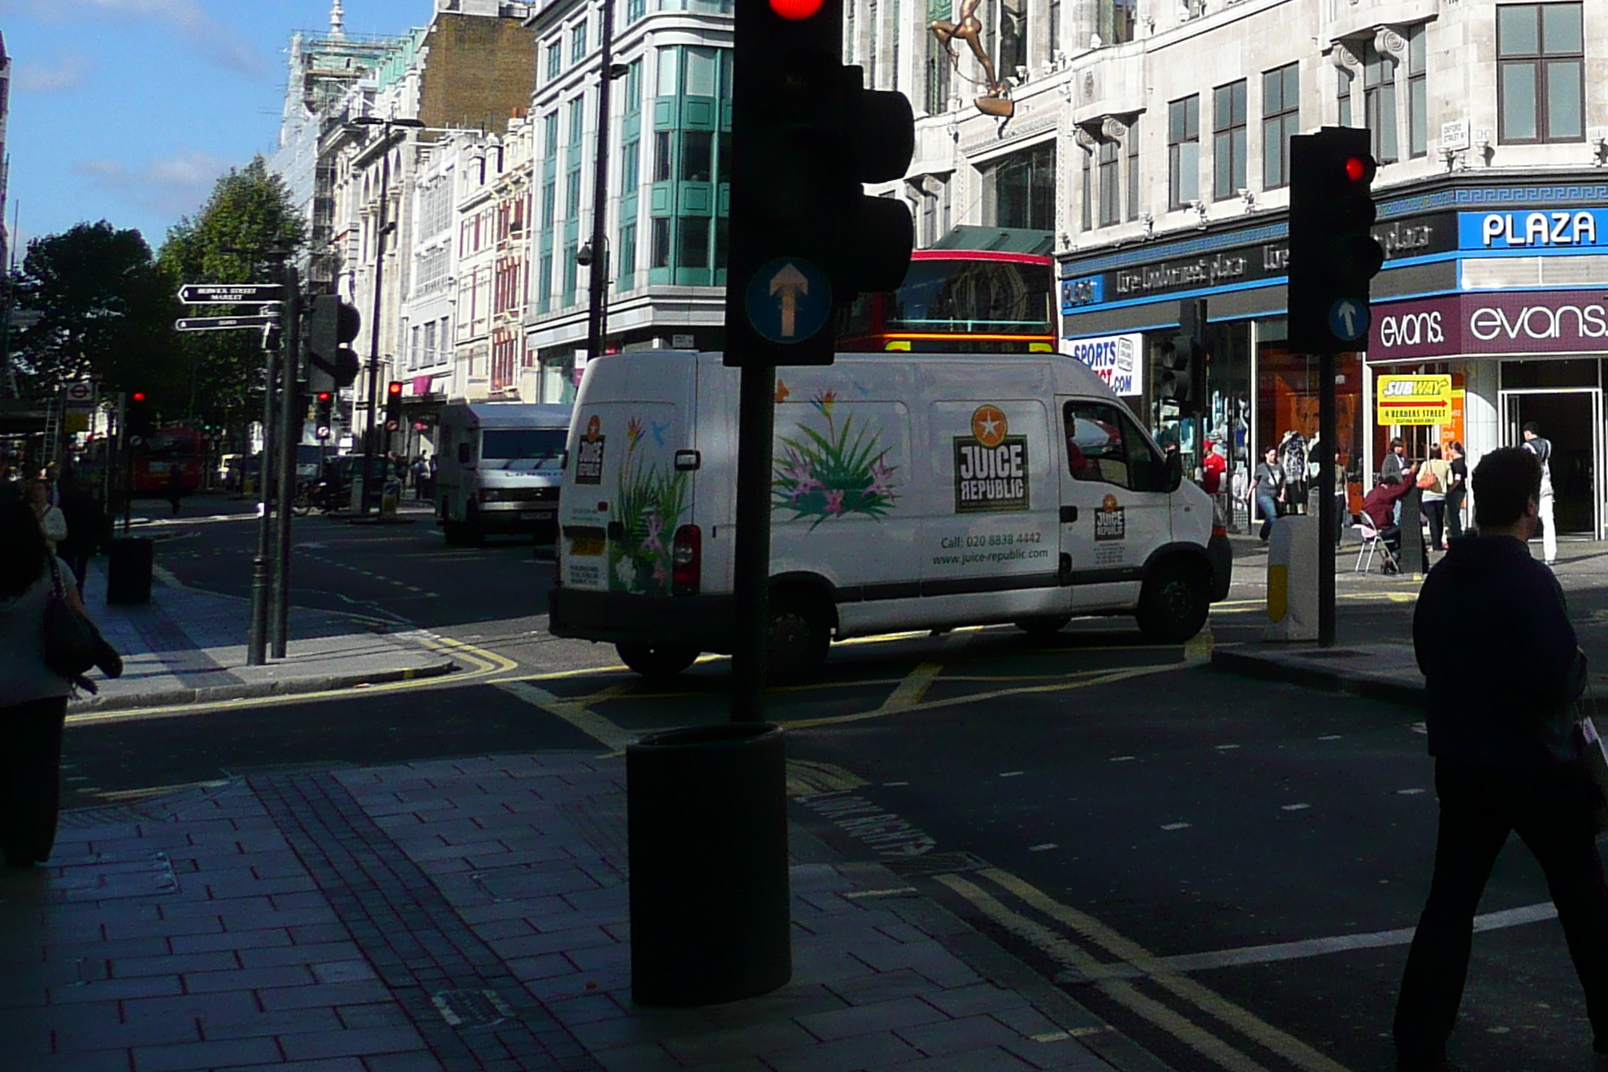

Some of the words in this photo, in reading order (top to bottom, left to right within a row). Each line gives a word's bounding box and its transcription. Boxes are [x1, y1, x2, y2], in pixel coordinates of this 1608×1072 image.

[1483, 211, 1596, 245] PLAZA
[1074, 341, 1116, 368] SPORTS
[1383, 379, 1448, 397] SUBWAY
[1391, 409, 1420, 418] BERNERS
[1422, 409, 1446, 417] STREET
[960, 445, 1024, 479] JUICE
[1097, 511, 1123, 526] JUICE
[941, 537, 964, 549] Call:
[966, 535, 986, 547] 020
[988, 534, 1013, 546] 8838
[1016, 532, 1041, 543] 4442
[933, 548, 1049, 565] www.juice-republic.com
